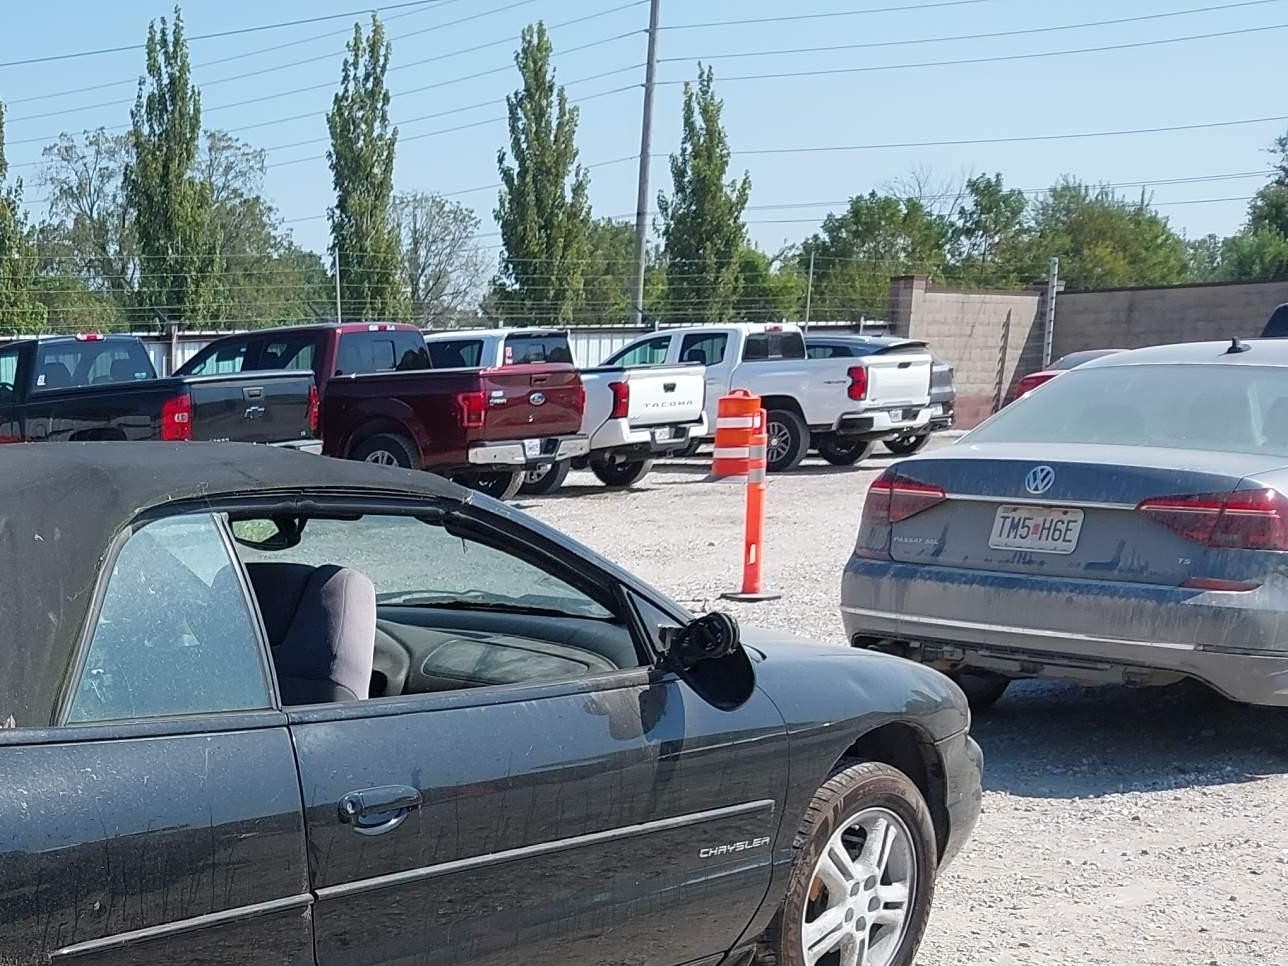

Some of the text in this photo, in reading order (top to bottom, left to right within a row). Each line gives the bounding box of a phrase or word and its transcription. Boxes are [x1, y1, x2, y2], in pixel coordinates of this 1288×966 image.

[643, 400, 693, 408] TACOMA
[998, 515, 1078, 543] TM5 H6E
[699, 836, 770, 858] CHRYSLER
